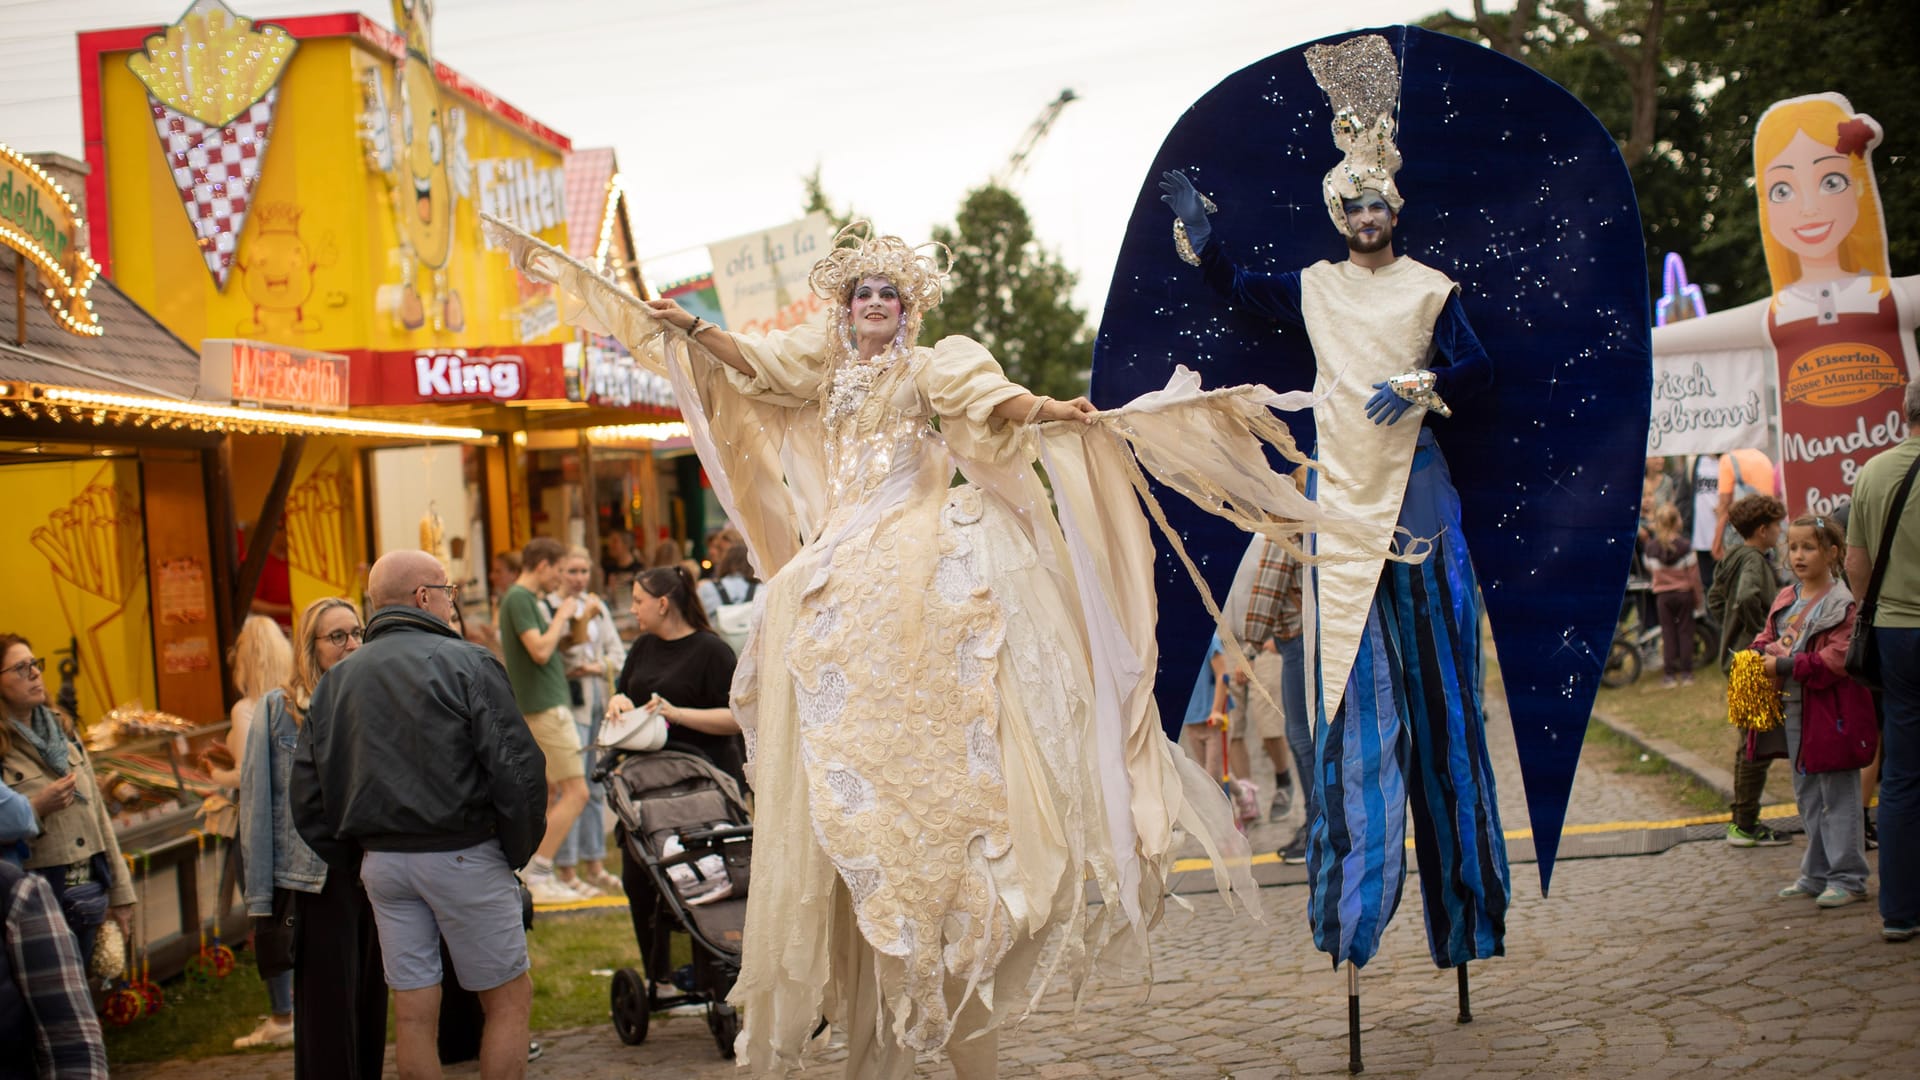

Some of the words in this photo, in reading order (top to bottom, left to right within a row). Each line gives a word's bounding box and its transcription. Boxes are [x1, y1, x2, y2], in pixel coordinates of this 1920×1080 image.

[415, 355, 520, 398] King
[1797, 362, 1813, 376] M.
[1815, 352, 1881, 368] Eiserloh
[1823, 368, 1895, 385] Mandelbar
[1650, 390, 1760, 449] gebrannt
[1841, 458, 1865, 485] &
